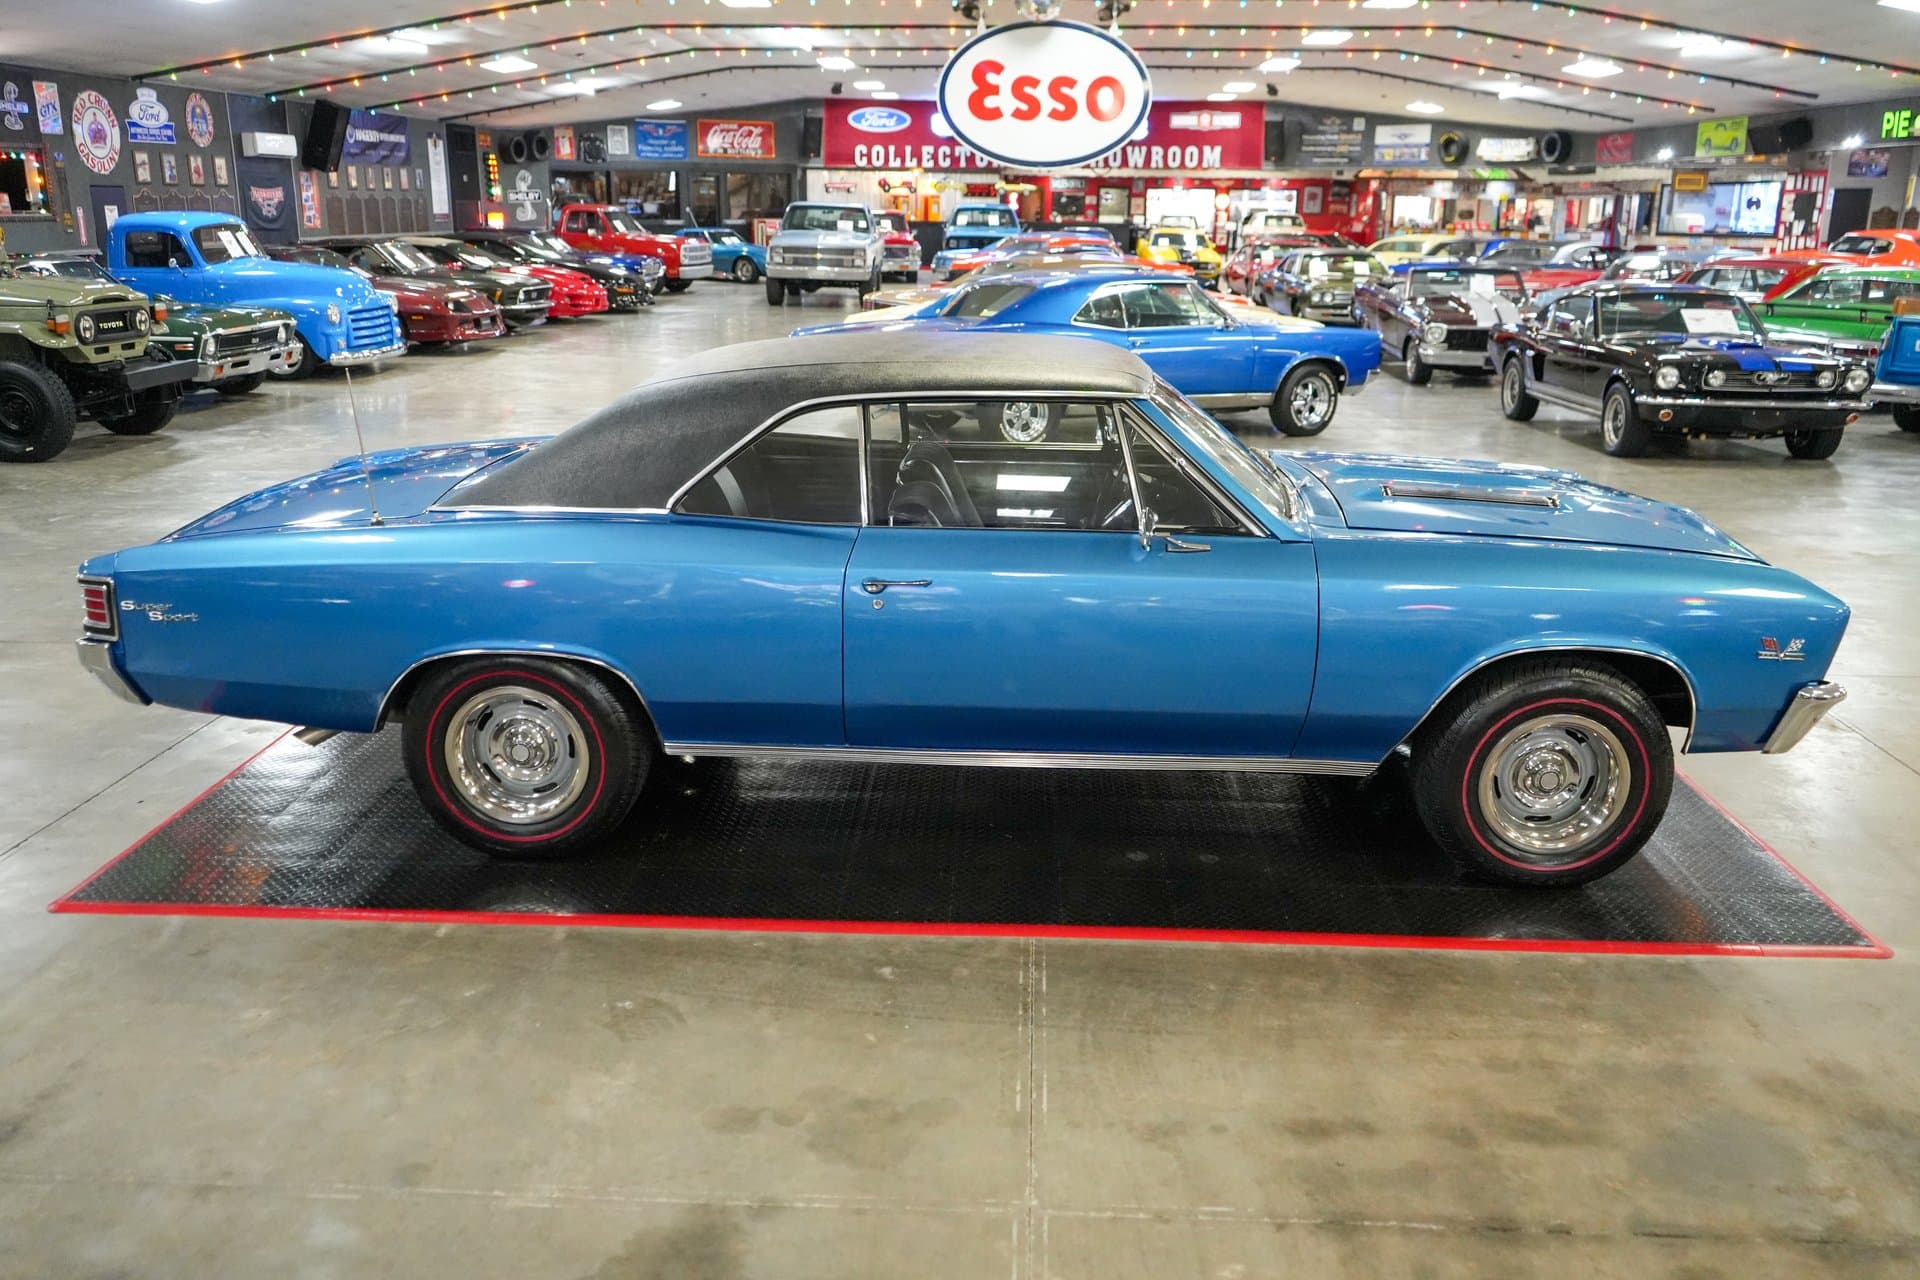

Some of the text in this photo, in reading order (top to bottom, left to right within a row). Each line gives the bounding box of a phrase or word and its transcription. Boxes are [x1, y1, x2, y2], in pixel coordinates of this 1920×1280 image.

[74, 93, 117, 128] RED CROWN
[138, 103, 161, 121] Ford
[861, 110, 897, 128] Ford
[1881, 110, 1912, 138] PIE
[79, 143, 120, 172] GASOLINE
[99, 320, 124, 329] TOYOTA
[120, 600, 173, 613] Super
[149, 610, 199, 623] Sport
